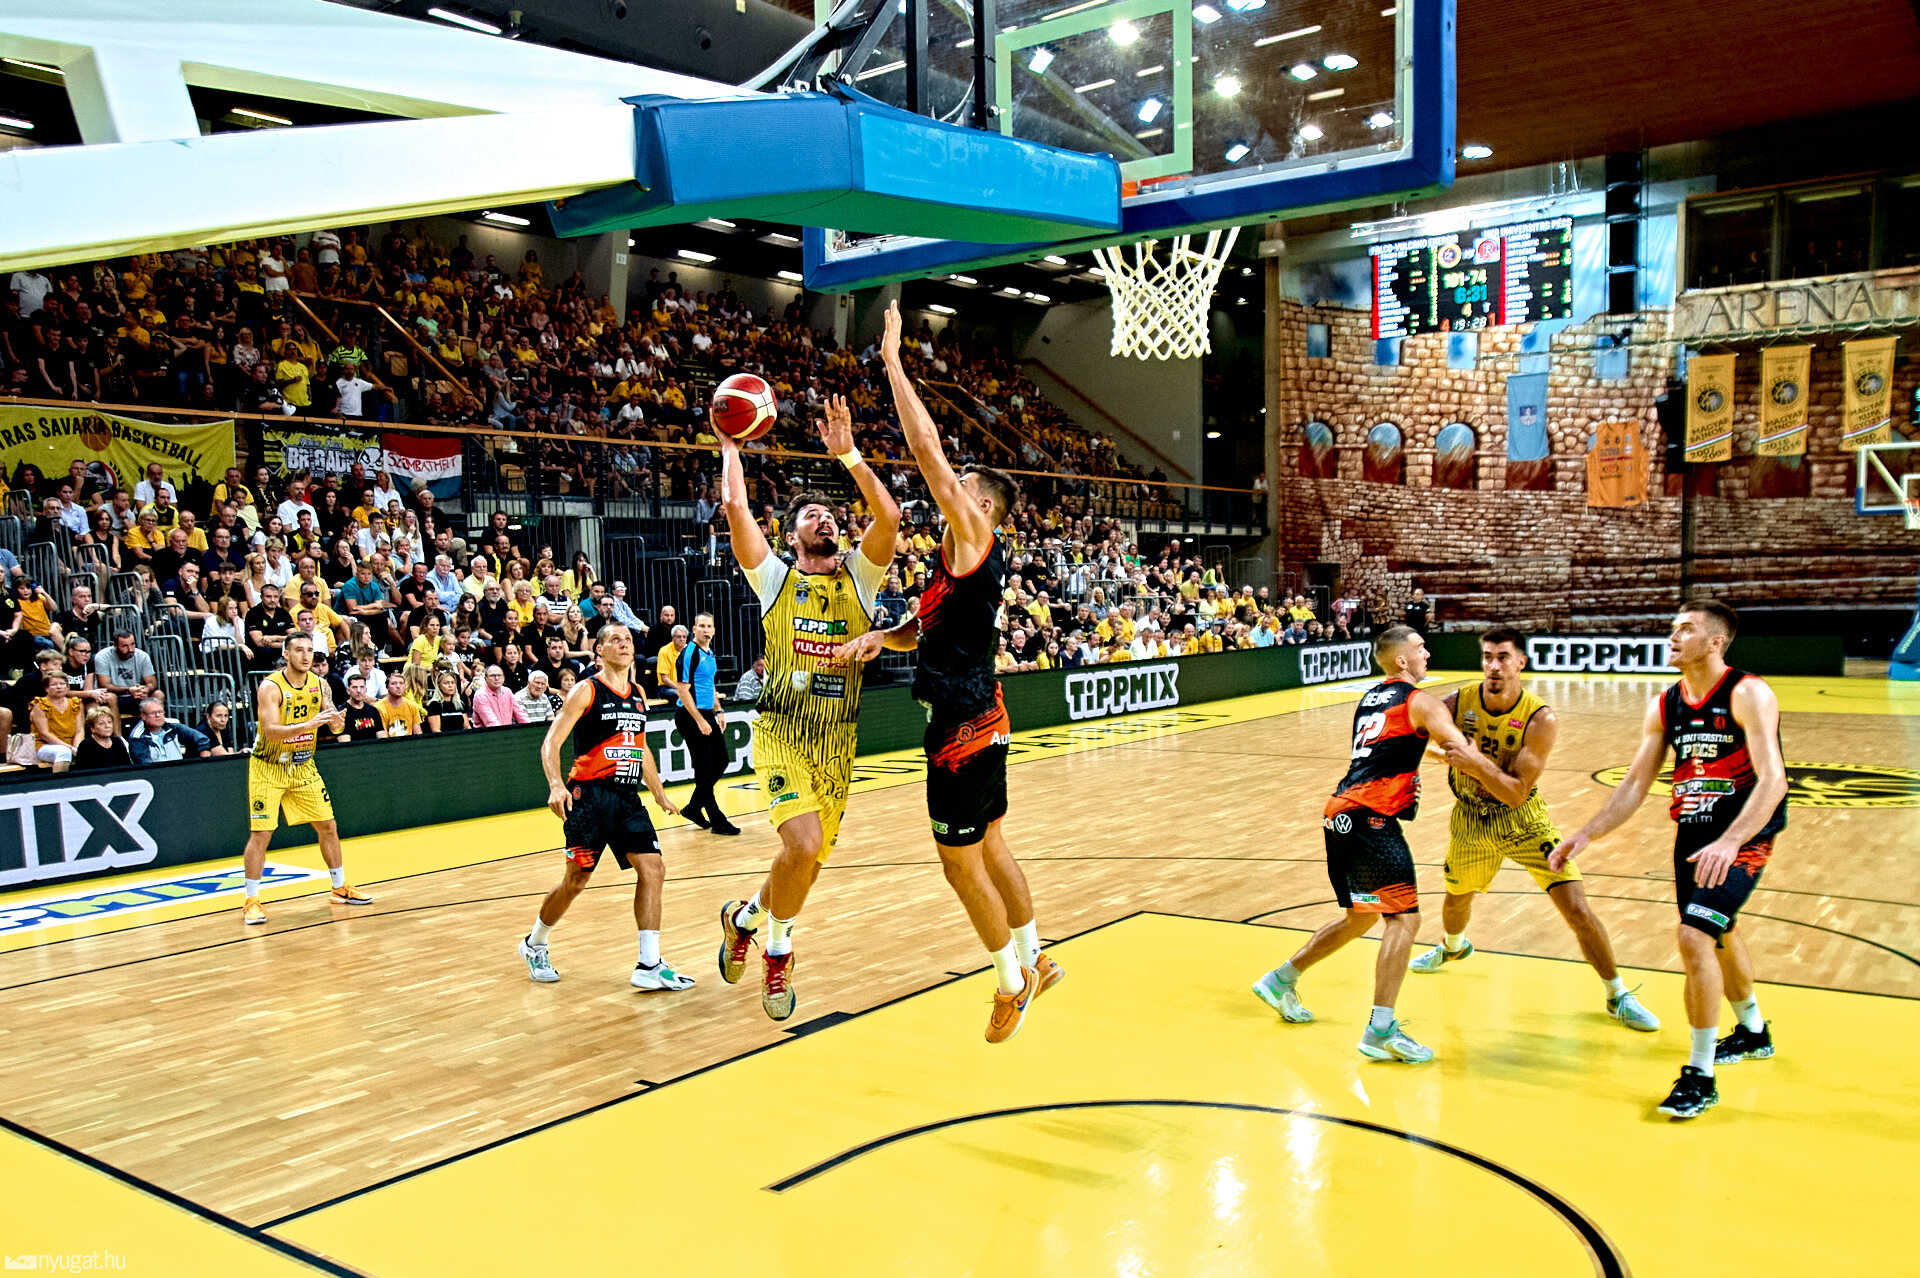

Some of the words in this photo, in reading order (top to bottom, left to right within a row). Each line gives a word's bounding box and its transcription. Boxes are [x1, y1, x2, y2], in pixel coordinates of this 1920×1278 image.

[1454, 285, 1487, 304] 6:31
[1701, 281, 1880, 334] ARENA
[38, 415, 107, 438] SAVARIA
[111, 420, 204, 470] BASKETBALL
[293, 704, 307, 719] 23
[622, 731, 636, 746] 11
[1481, 735, 1499, 759] 22
[1693, 759, 1705, 776] 5
